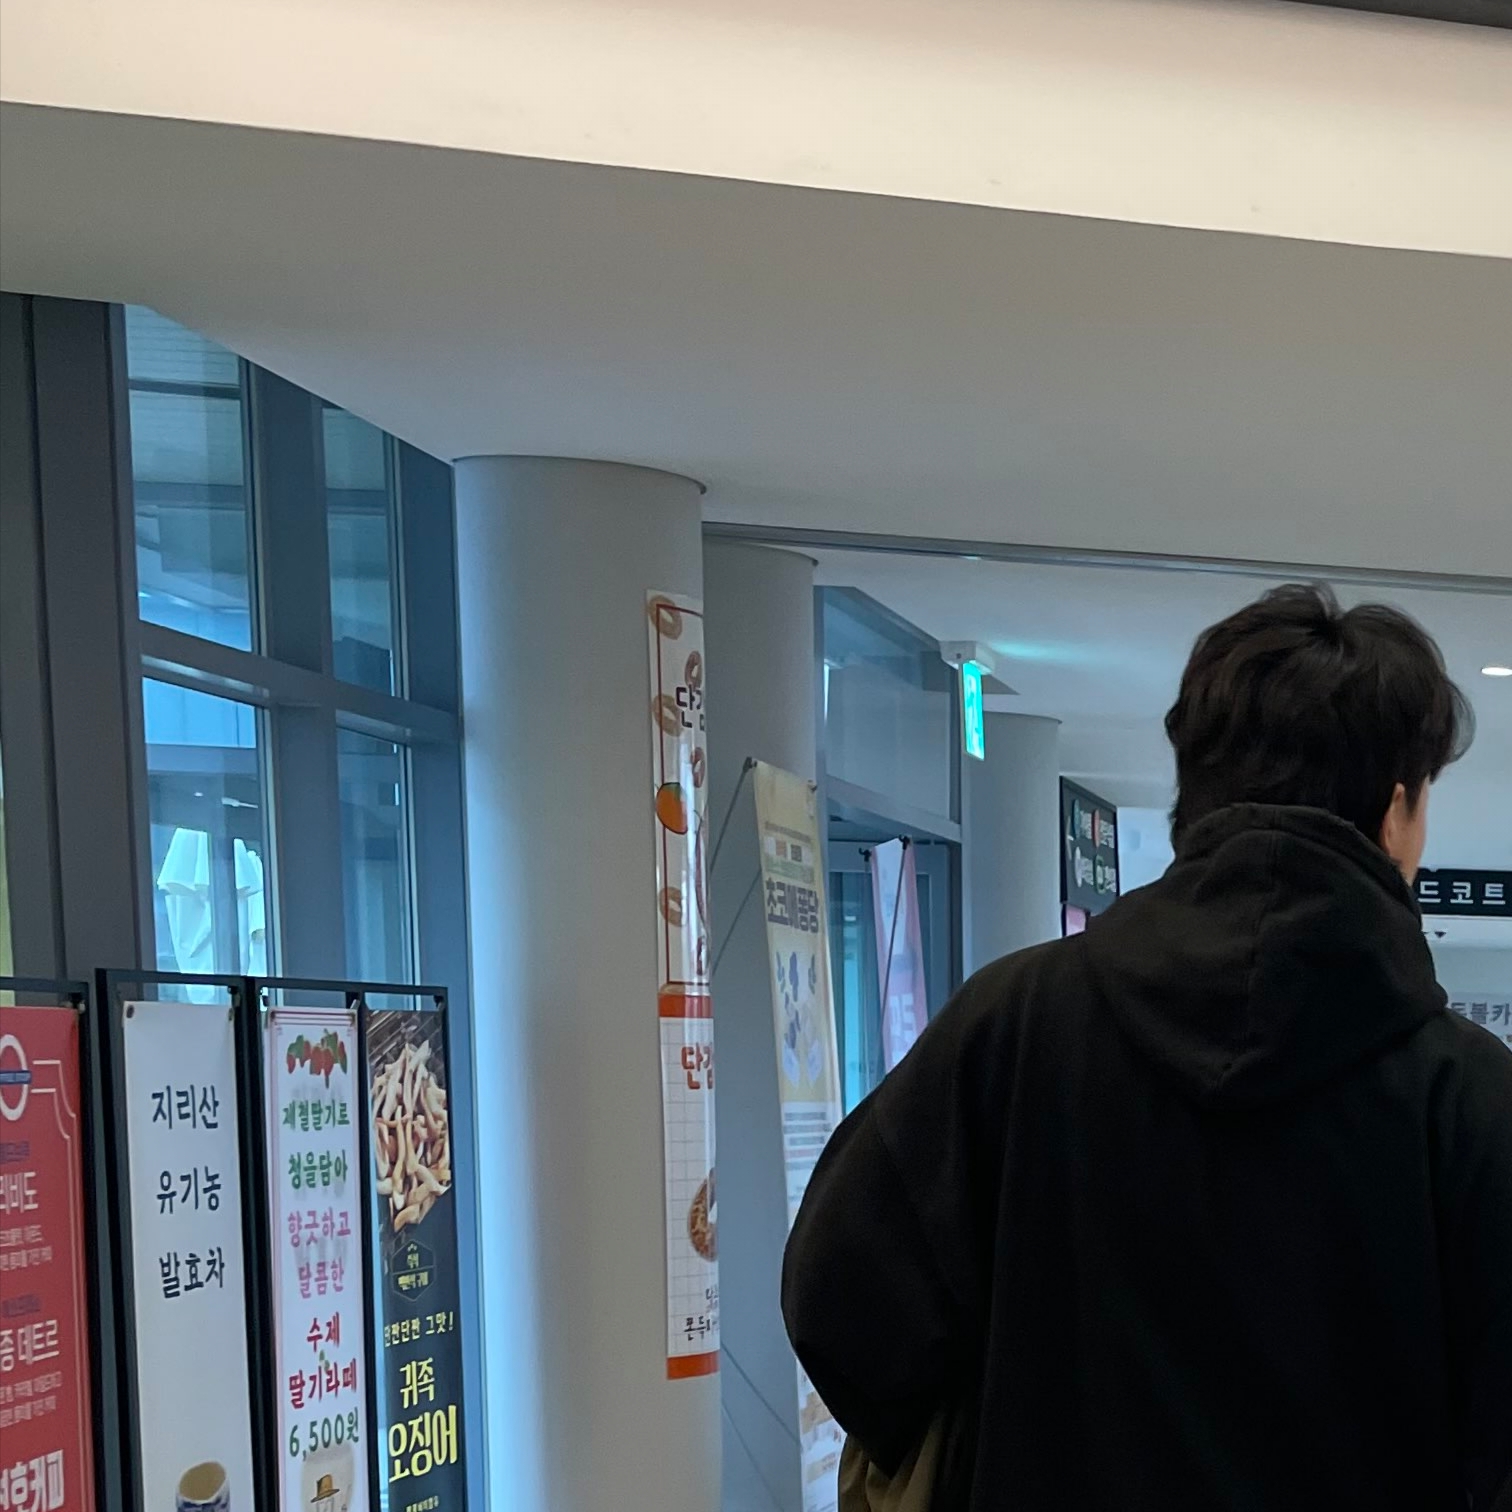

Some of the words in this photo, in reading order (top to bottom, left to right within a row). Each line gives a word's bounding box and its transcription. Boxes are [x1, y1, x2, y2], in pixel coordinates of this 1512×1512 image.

[151, 1084, 220, 1130] 지리산
[156, 1166, 222, 1213] 유기농
[288, 1207, 351, 1248] 향긋하고
[158, 1247, 226, 1299] 발효차
[298, 1257, 345, 1300] 달콤한
[306, 1311, 341, 1353] 수제
[289, 1356, 358, 1409] 딸기라떼
[400, 1357, 436, 1408] 귀족
[289, 1408, 360, 1462] 6,500원
[388, 1404, 458, 1483] 오징어
